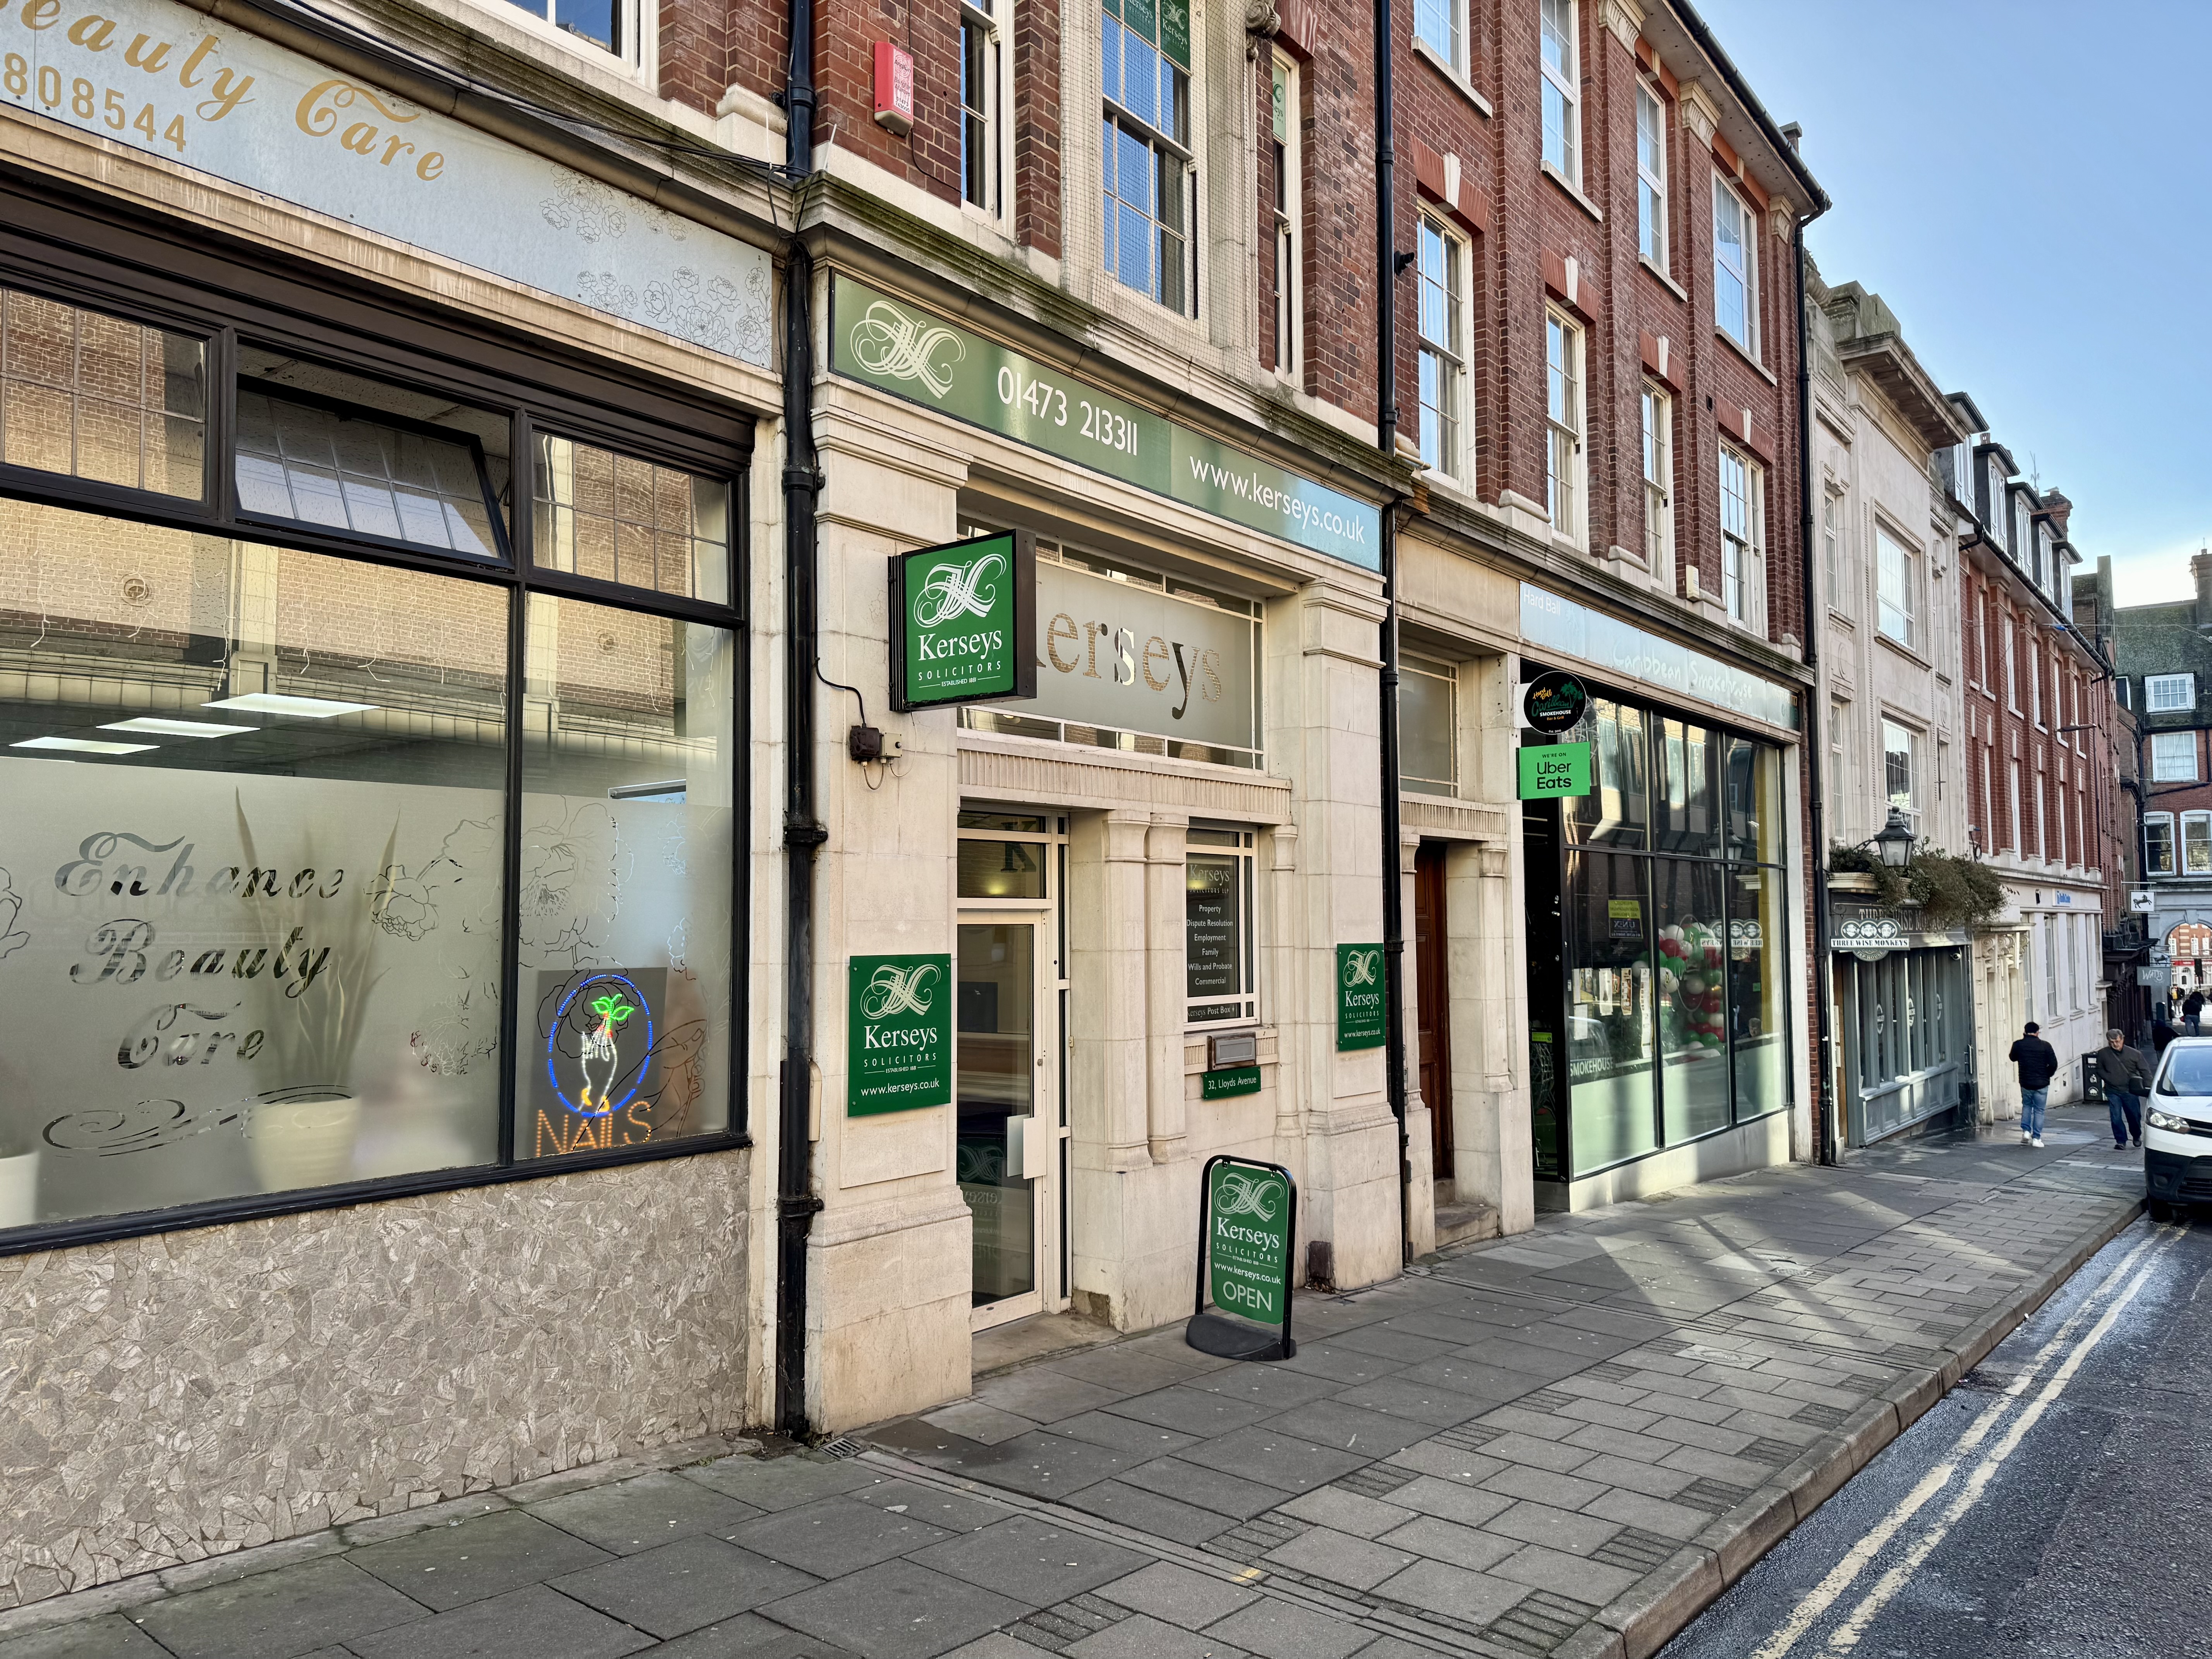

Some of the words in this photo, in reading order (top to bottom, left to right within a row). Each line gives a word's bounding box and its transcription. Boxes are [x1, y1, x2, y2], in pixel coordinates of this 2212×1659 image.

[1163, 17, 1188, 45] Kerseys
[0, 0, 256, 122] eauty
[295, 79, 445, 181] Care
[4, 52, 186, 152] 808544
[997, 366, 1068, 427] 01473
[1080, 400, 1138, 457] 213311
[1190, 456, 1365, 545] www.kerseys.co.uk
[1523, 588, 1544, 610] Hard
[1546, 597, 1561, 616] Ball
[918, 629, 1002, 662] Kerseys
[918, 661, 1001, 681] SOLICITORS
[1037, 604, 1222, 720] erseys
[941, 678, 967, 687] ESTABLISHED
[1531, 694, 1569, 717] Caribbean
[1537, 761, 1571, 775] Uber
[1537, 776, 1572, 790] Eats
[54, 832, 344, 899] Enhance
[1190, 864, 1230, 886] Kerseys
[1199, 904, 1221, 914] Property
[1187, 919, 1206, 928] Dispute
[1194, 934, 1226, 943] Employment
[70, 919, 332, 998] Beauty
[1202, 948, 1219, 957] Family
[1202, 962, 1212, 970] and
[1195, 977, 1226, 985] Commercial
[1345, 990, 1379, 1009] Kerseys
[1207, 1007, 1219, 1015] Post
[1345, 1010, 1379, 1019] SOLICITORS
[117, 1001, 265, 1069] Care
[864, 1025, 938, 1051] Kerseys
[864, 1053, 937, 1067] SOLICITORS
[1570, 1057, 1613, 1077] SMOKEHOUSE
[860, 1078, 940, 1096] www.kerseys.co.uk
[1208, 1080, 1216, 1090] 32,
[1218, 1078, 1236, 1090] Lloyds
[1237, 1077, 1257, 1085] Avenue
[536, 1100, 652, 1158] NAILS
[1217, 1217, 1279, 1251] Kerseys
[1216, 1242, 1278, 1263] SOLICITORS
[1214, 1262, 1281, 1285] www.kerseys.co.uk
[1222, 1281, 1272, 1312] OPEN
